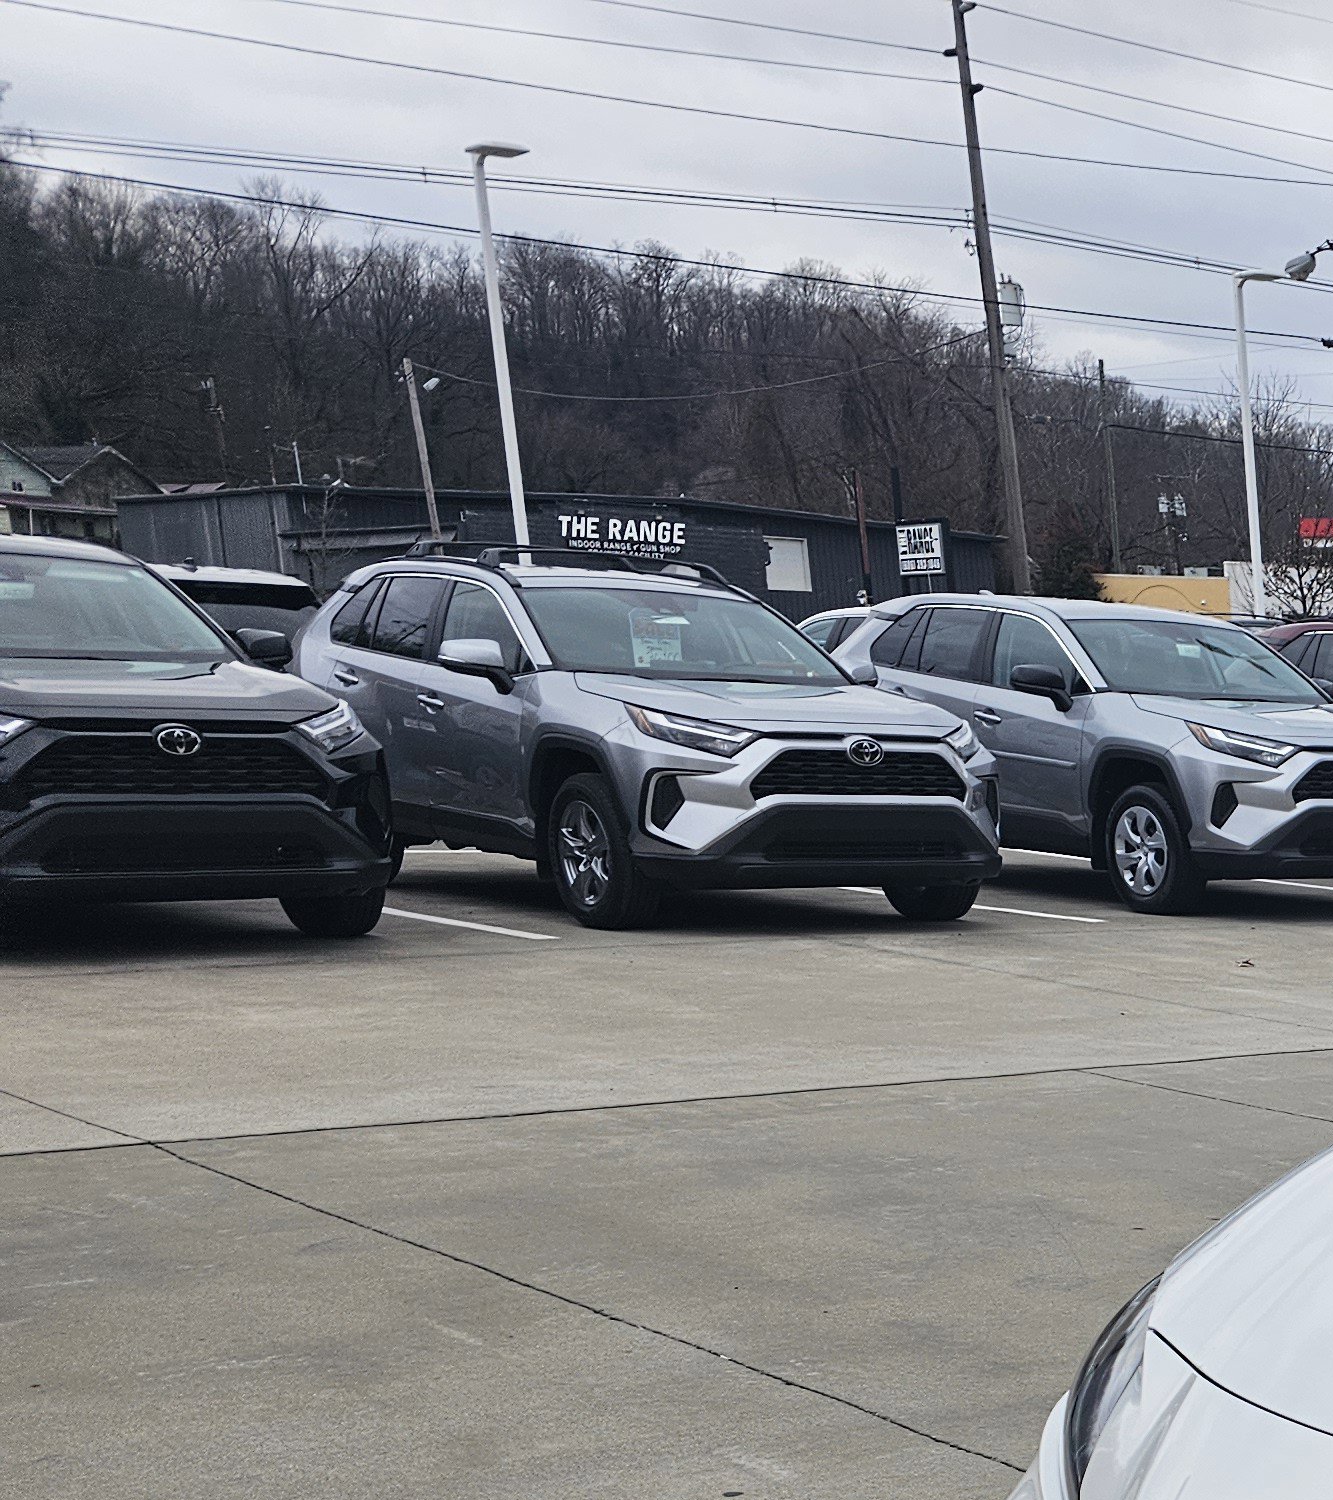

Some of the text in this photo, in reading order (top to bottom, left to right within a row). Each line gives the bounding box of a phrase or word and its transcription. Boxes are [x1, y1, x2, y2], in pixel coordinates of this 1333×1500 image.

[558, 515, 686, 545] THE RANGE
[568, 539, 601, 549] INDOOR
[603, 541, 631, 551] RANGE
[640, 544, 658, 552] GUN
[659, 545, 681, 554] SHOP
